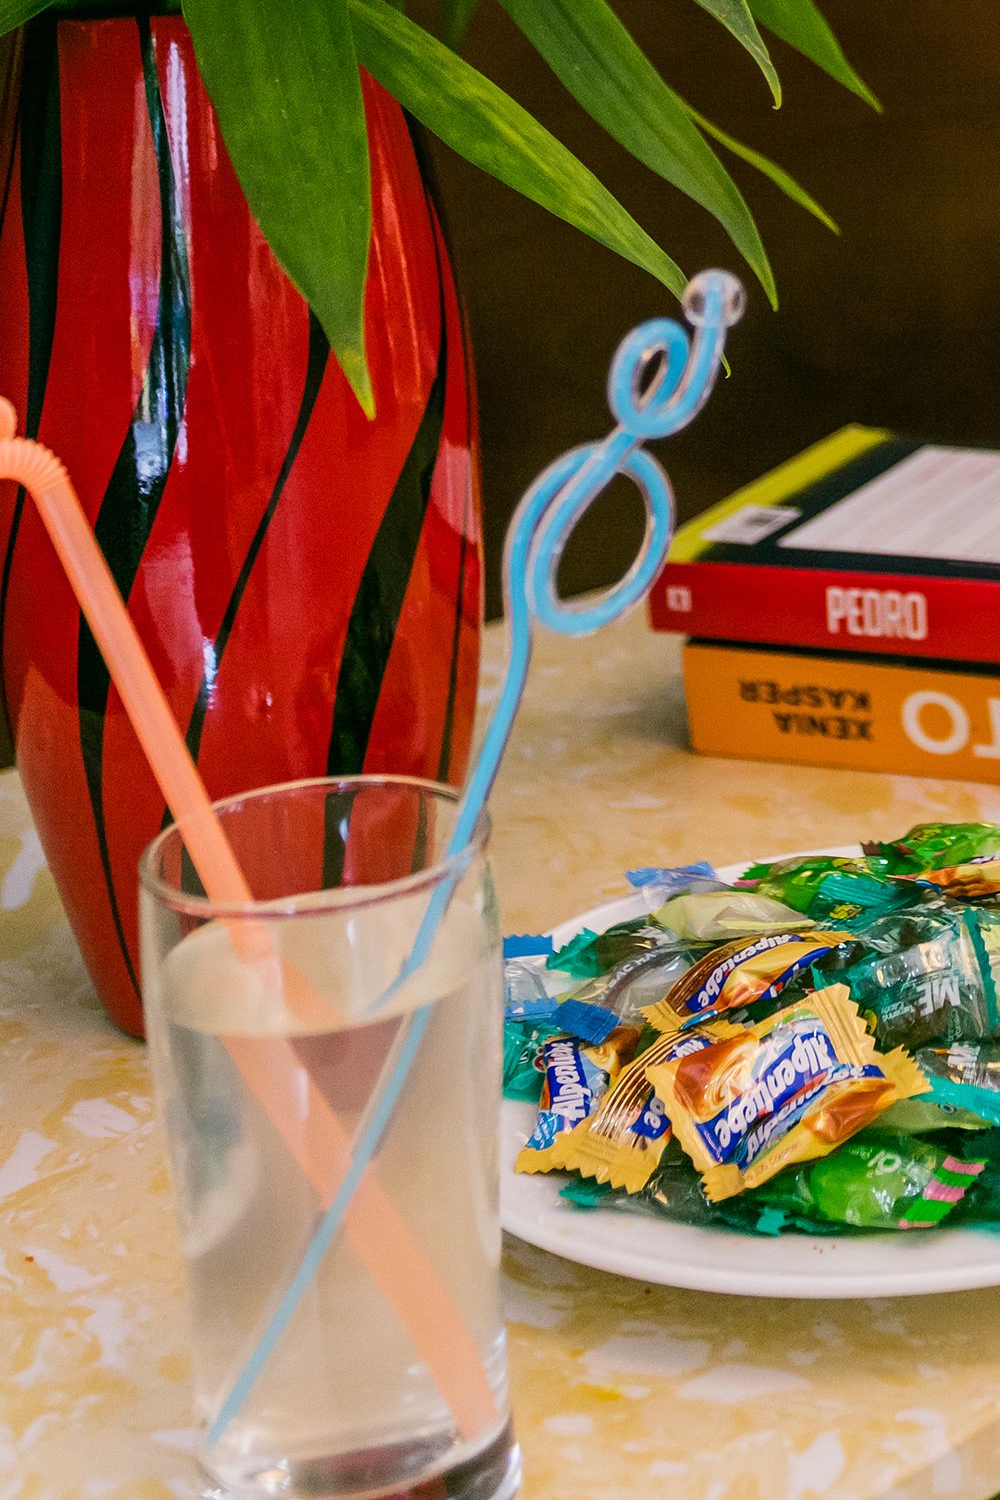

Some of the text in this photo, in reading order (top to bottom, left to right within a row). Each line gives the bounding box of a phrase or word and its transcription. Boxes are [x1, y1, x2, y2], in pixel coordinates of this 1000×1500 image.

[826, 586, 927, 641] PEDRO
[737, 679, 872, 711] KASPER
[771, 711, 874, 742] XENIA
[713, 1033, 833, 1149] Alpenliebe
